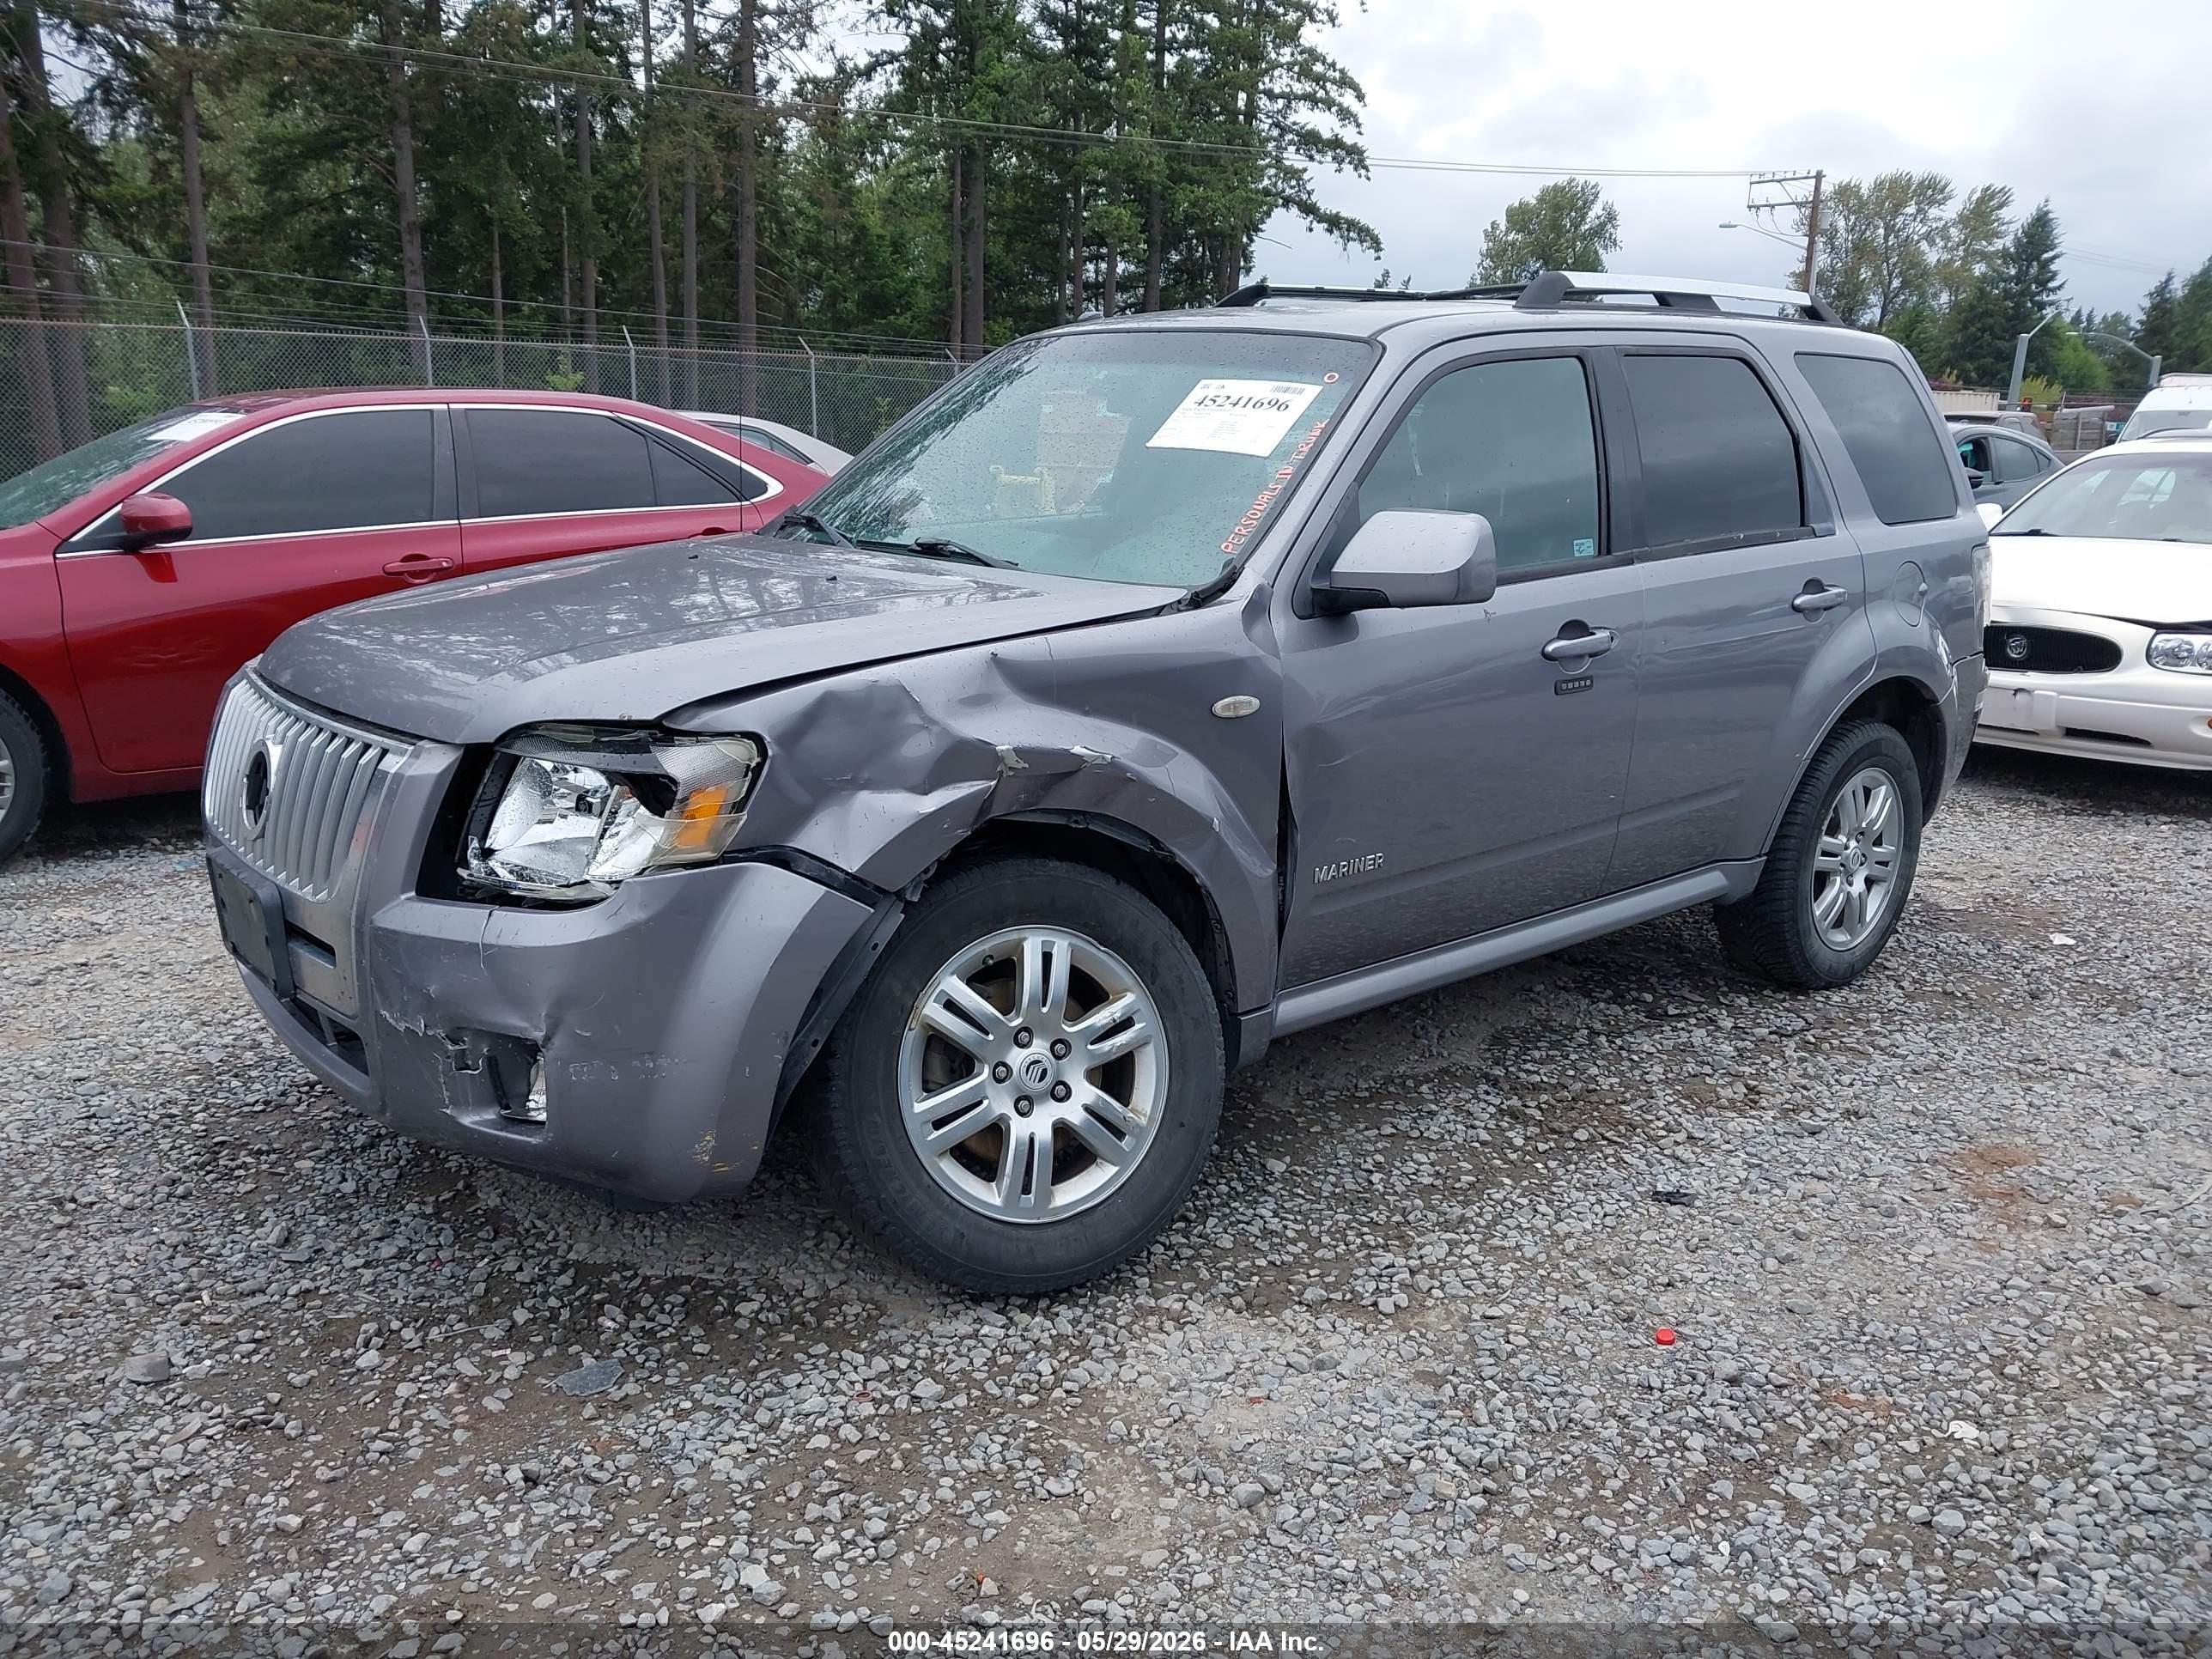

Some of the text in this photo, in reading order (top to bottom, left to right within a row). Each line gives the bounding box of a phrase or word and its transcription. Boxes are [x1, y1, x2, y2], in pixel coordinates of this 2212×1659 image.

[1194, 394, 1293, 412] 45241696
[1221, 483, 1282, 554] PERSONALS
[1291, 418, 1330, 462] TRUNK
[1314, 853, 1385, 884] MARINER
